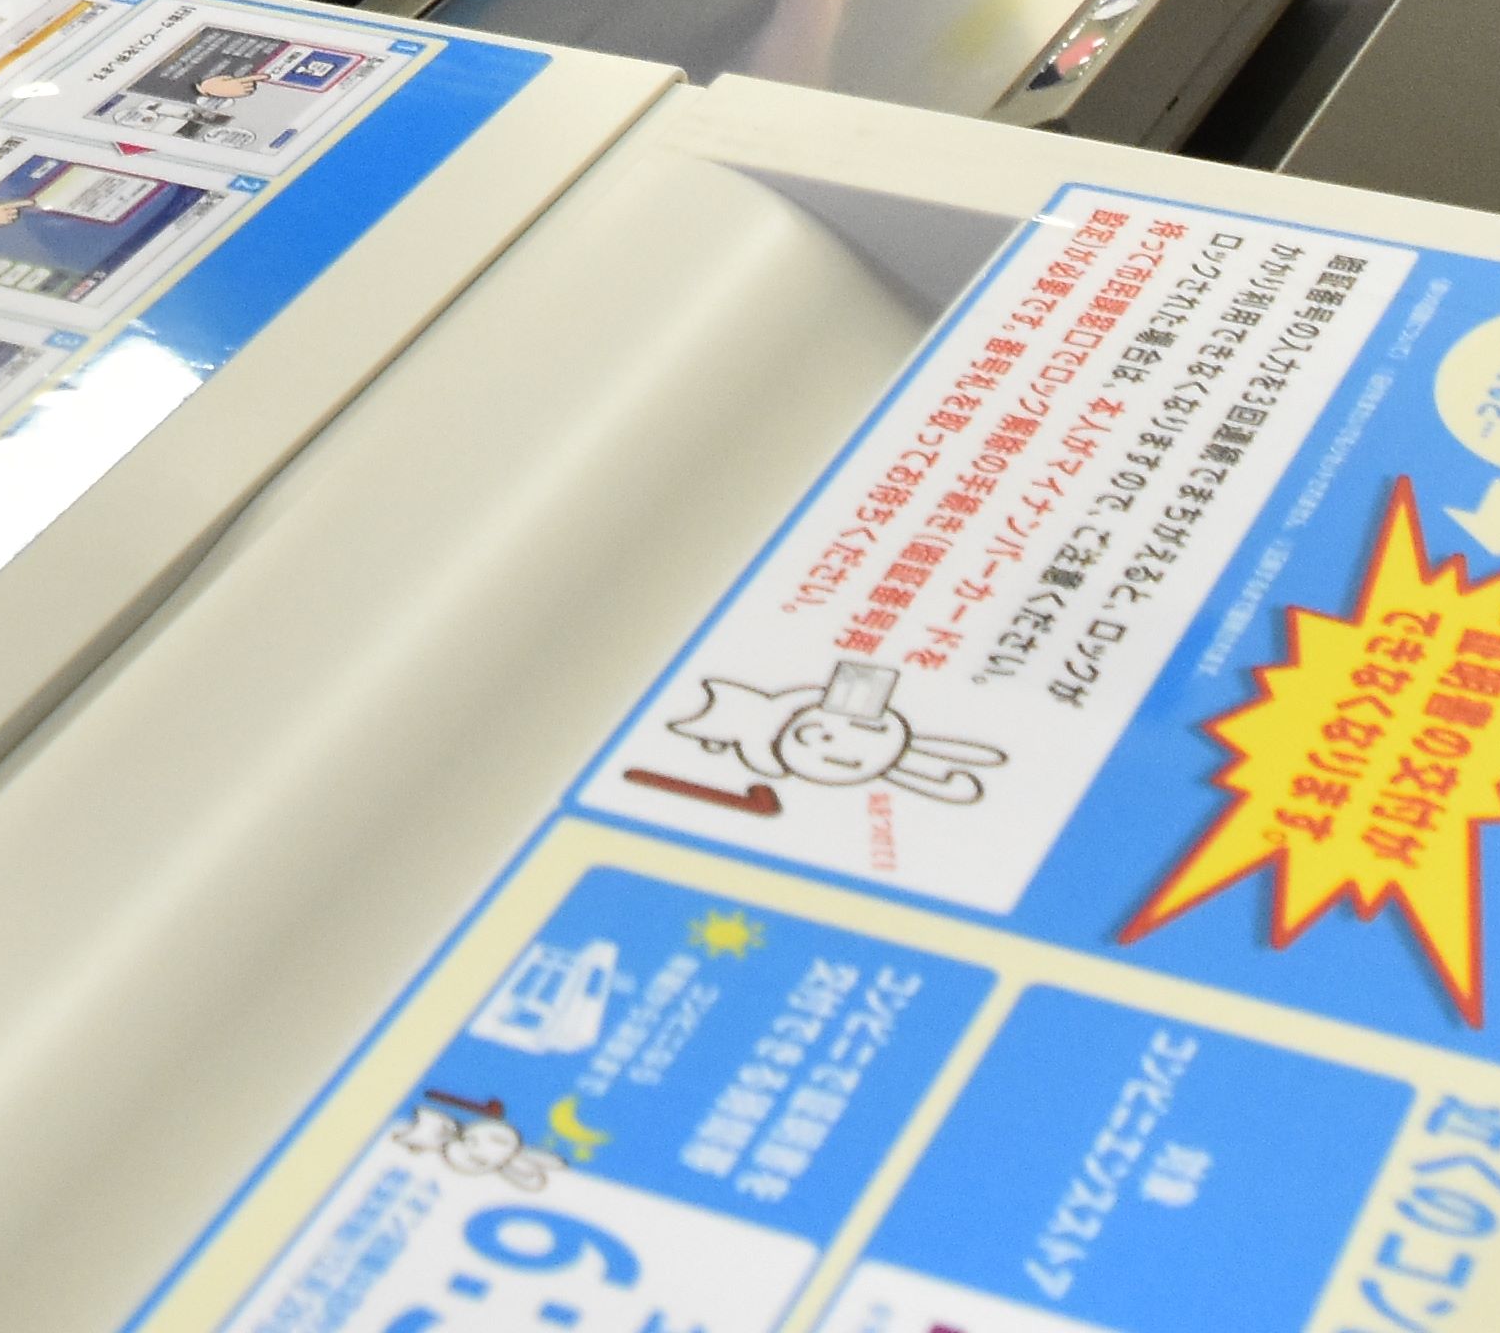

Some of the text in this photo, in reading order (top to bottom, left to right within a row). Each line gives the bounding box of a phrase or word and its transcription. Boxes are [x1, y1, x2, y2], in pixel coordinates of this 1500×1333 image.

[965, 241, 1308, 692] かかり利用できなくなりますので、ご注意ください。
[1037, 253, 1370, 710] 暗証番号の入力を3回連続でまちがえると、ロックが
[1256, 601, 1442, 861] できなくなります。
[727, 964, 926, 1207] コンビニで証明書を
[1009, 1028, 1200, 1302] コンビニエンスストア
[410, 1202, 641, 1333] 6:
